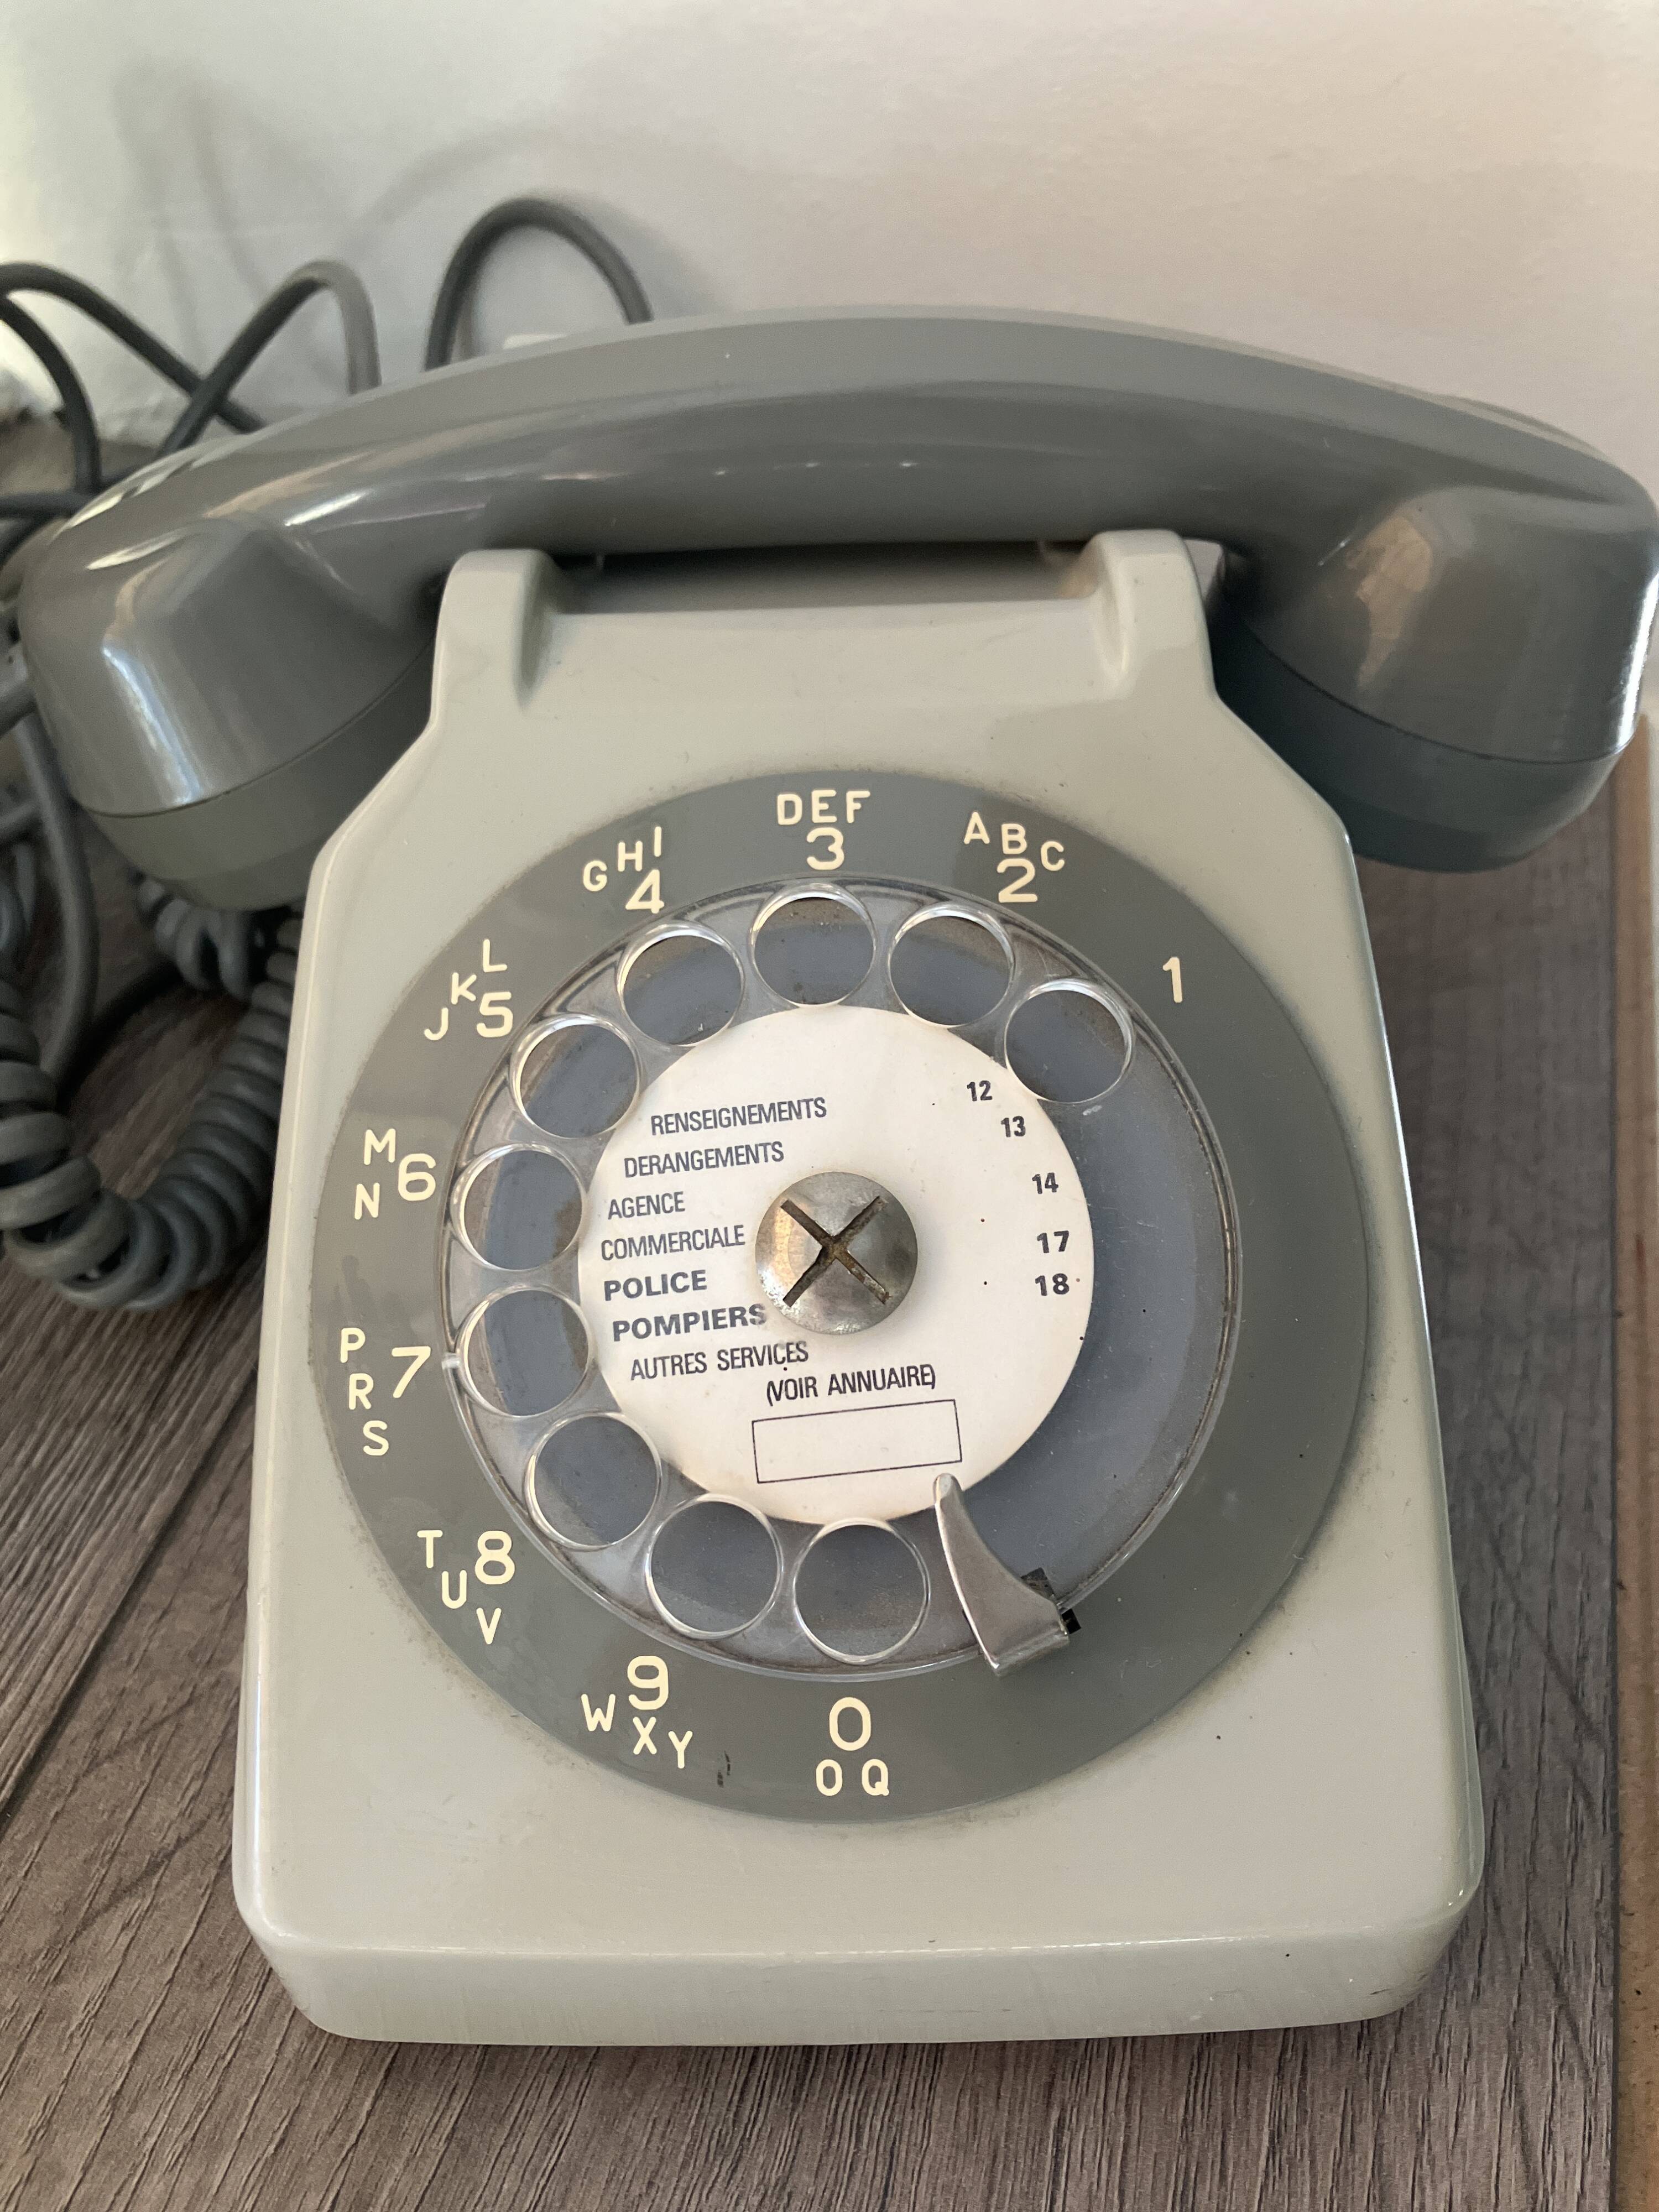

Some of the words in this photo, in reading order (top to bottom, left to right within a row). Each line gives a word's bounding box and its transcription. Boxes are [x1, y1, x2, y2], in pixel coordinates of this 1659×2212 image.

[806, 827, 844, 870] 3
[625, 869, 665, 914] 4
[997, 858, 1038, 903] 2
[1162, 957, 1183, 1003] 1
[476, 991, 514, 1038] 5
[967, 1080, 993, 1102] 12
[650, 1097, 827, 1136] RENSEIGNEMENTS
[1000, 1115, 1026, 1138] 13
[398, 1153, 436, 1201] 6
[624, 1141, 784, 1178] DERANGEMENTS
[1031, 1172, 1059, 1194] 14
[607, 1191, 686, 1220] AGENCE
[601, 1224, 746, 1261] COMMERCIALE
[1036, 1230, 1070, 1254] 17
[604, 1269, 707, 1301] POLICE
[1035, 1273, 1070, 1296] 18
[612, 1303, 767, 1342] POMPIERS
[391, 1345, 431, 1399] 7
[630, 1352, 707, 1381] AUTRES
[717, 1340, 809, 1371] SERVICES
[766, 1376, 818, 1407] (VOIR
[827, 1364, 936, 1396] ANNUAIRE)
[474, 1530, 515, 1585] 8
[627, 1655, 669, 1710] 9
